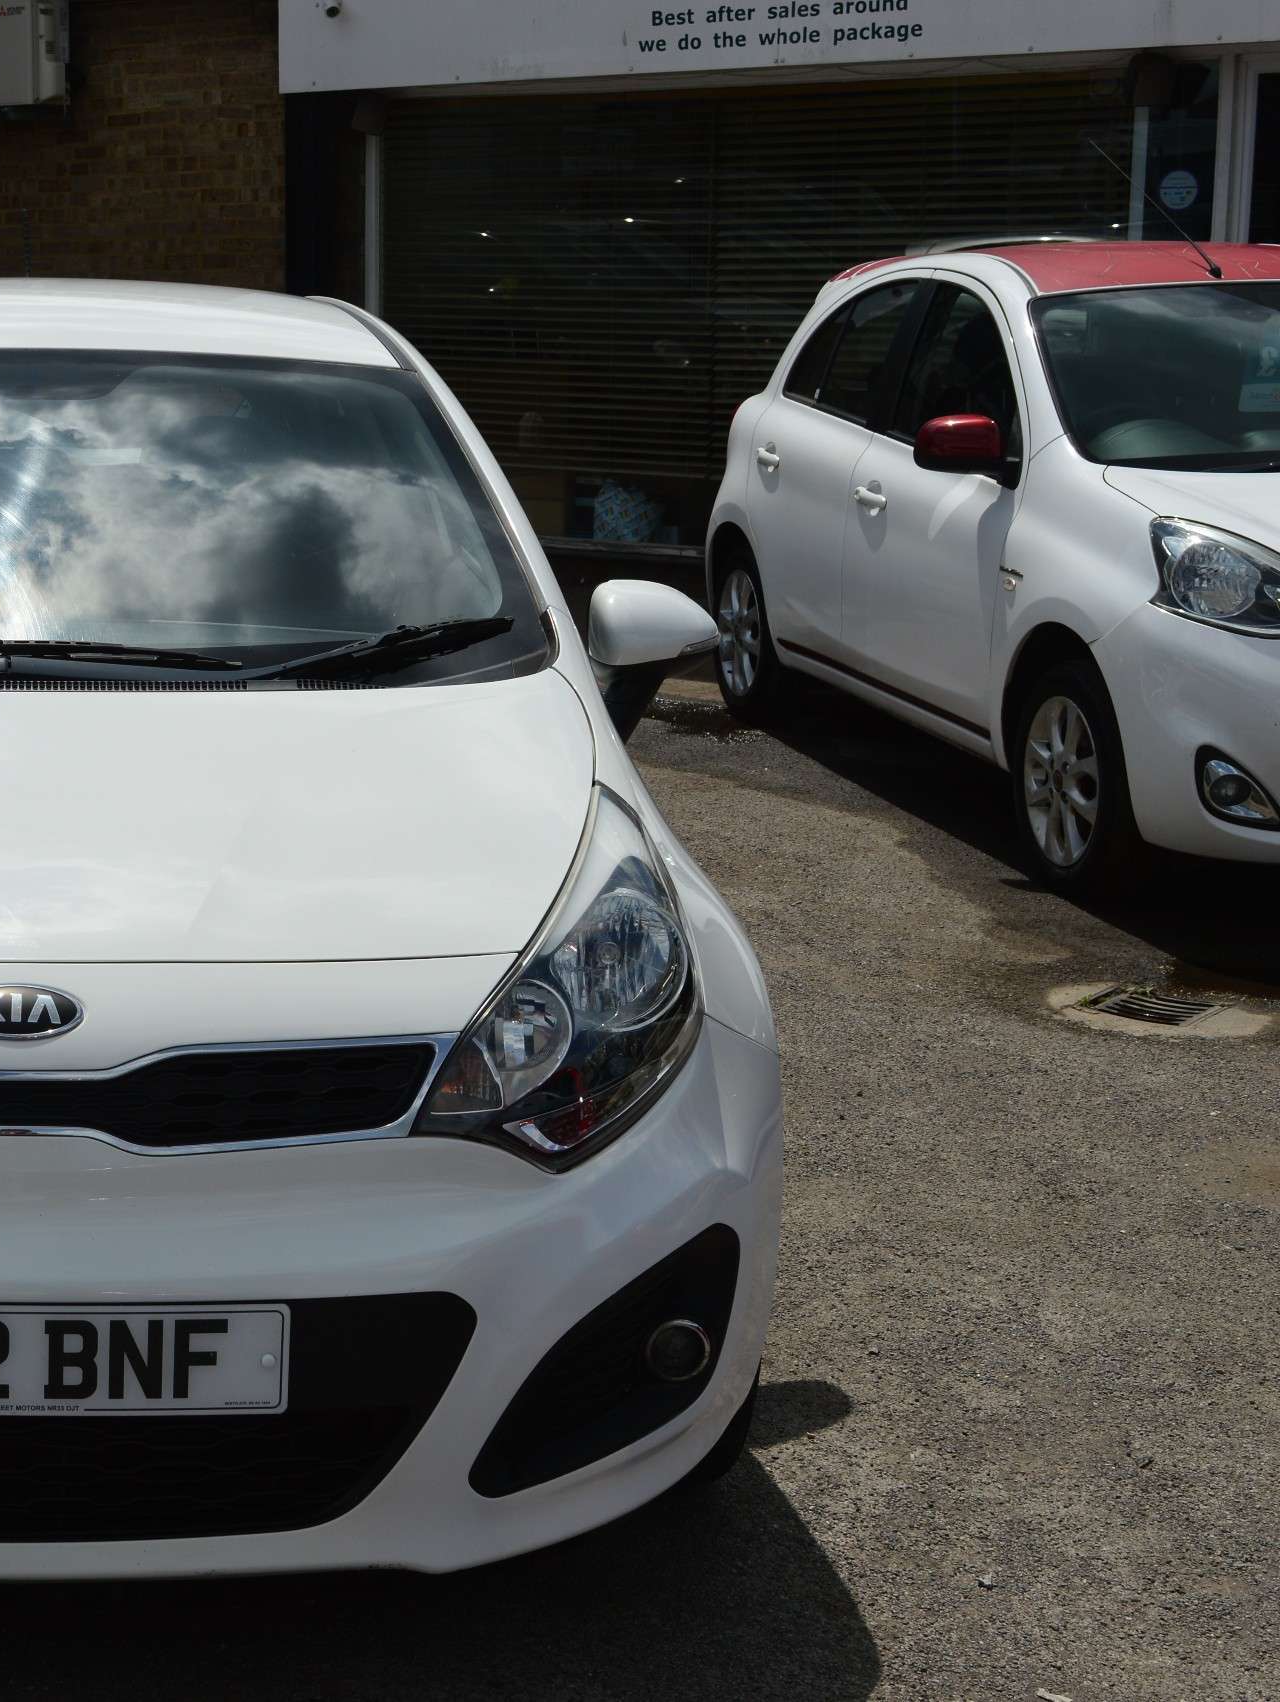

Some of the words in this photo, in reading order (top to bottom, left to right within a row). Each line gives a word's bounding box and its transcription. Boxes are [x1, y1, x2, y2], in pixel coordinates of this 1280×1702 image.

[651, 9, 695, 26] Best
[706, 5, 756, 24] after
[767, 1, 821, 20] sales
[832, 0, 908, 15] around
[638, 38, 667, 53] we
[677, 33, 702, 51] do
[713, 31, 747, 49] the
[758, 27, 821, 46] whole
[832, 21, 924, 46] package
[43, 1318, 229, 1400] BNF
[16, 1404, 46, 1412] MOTORS
